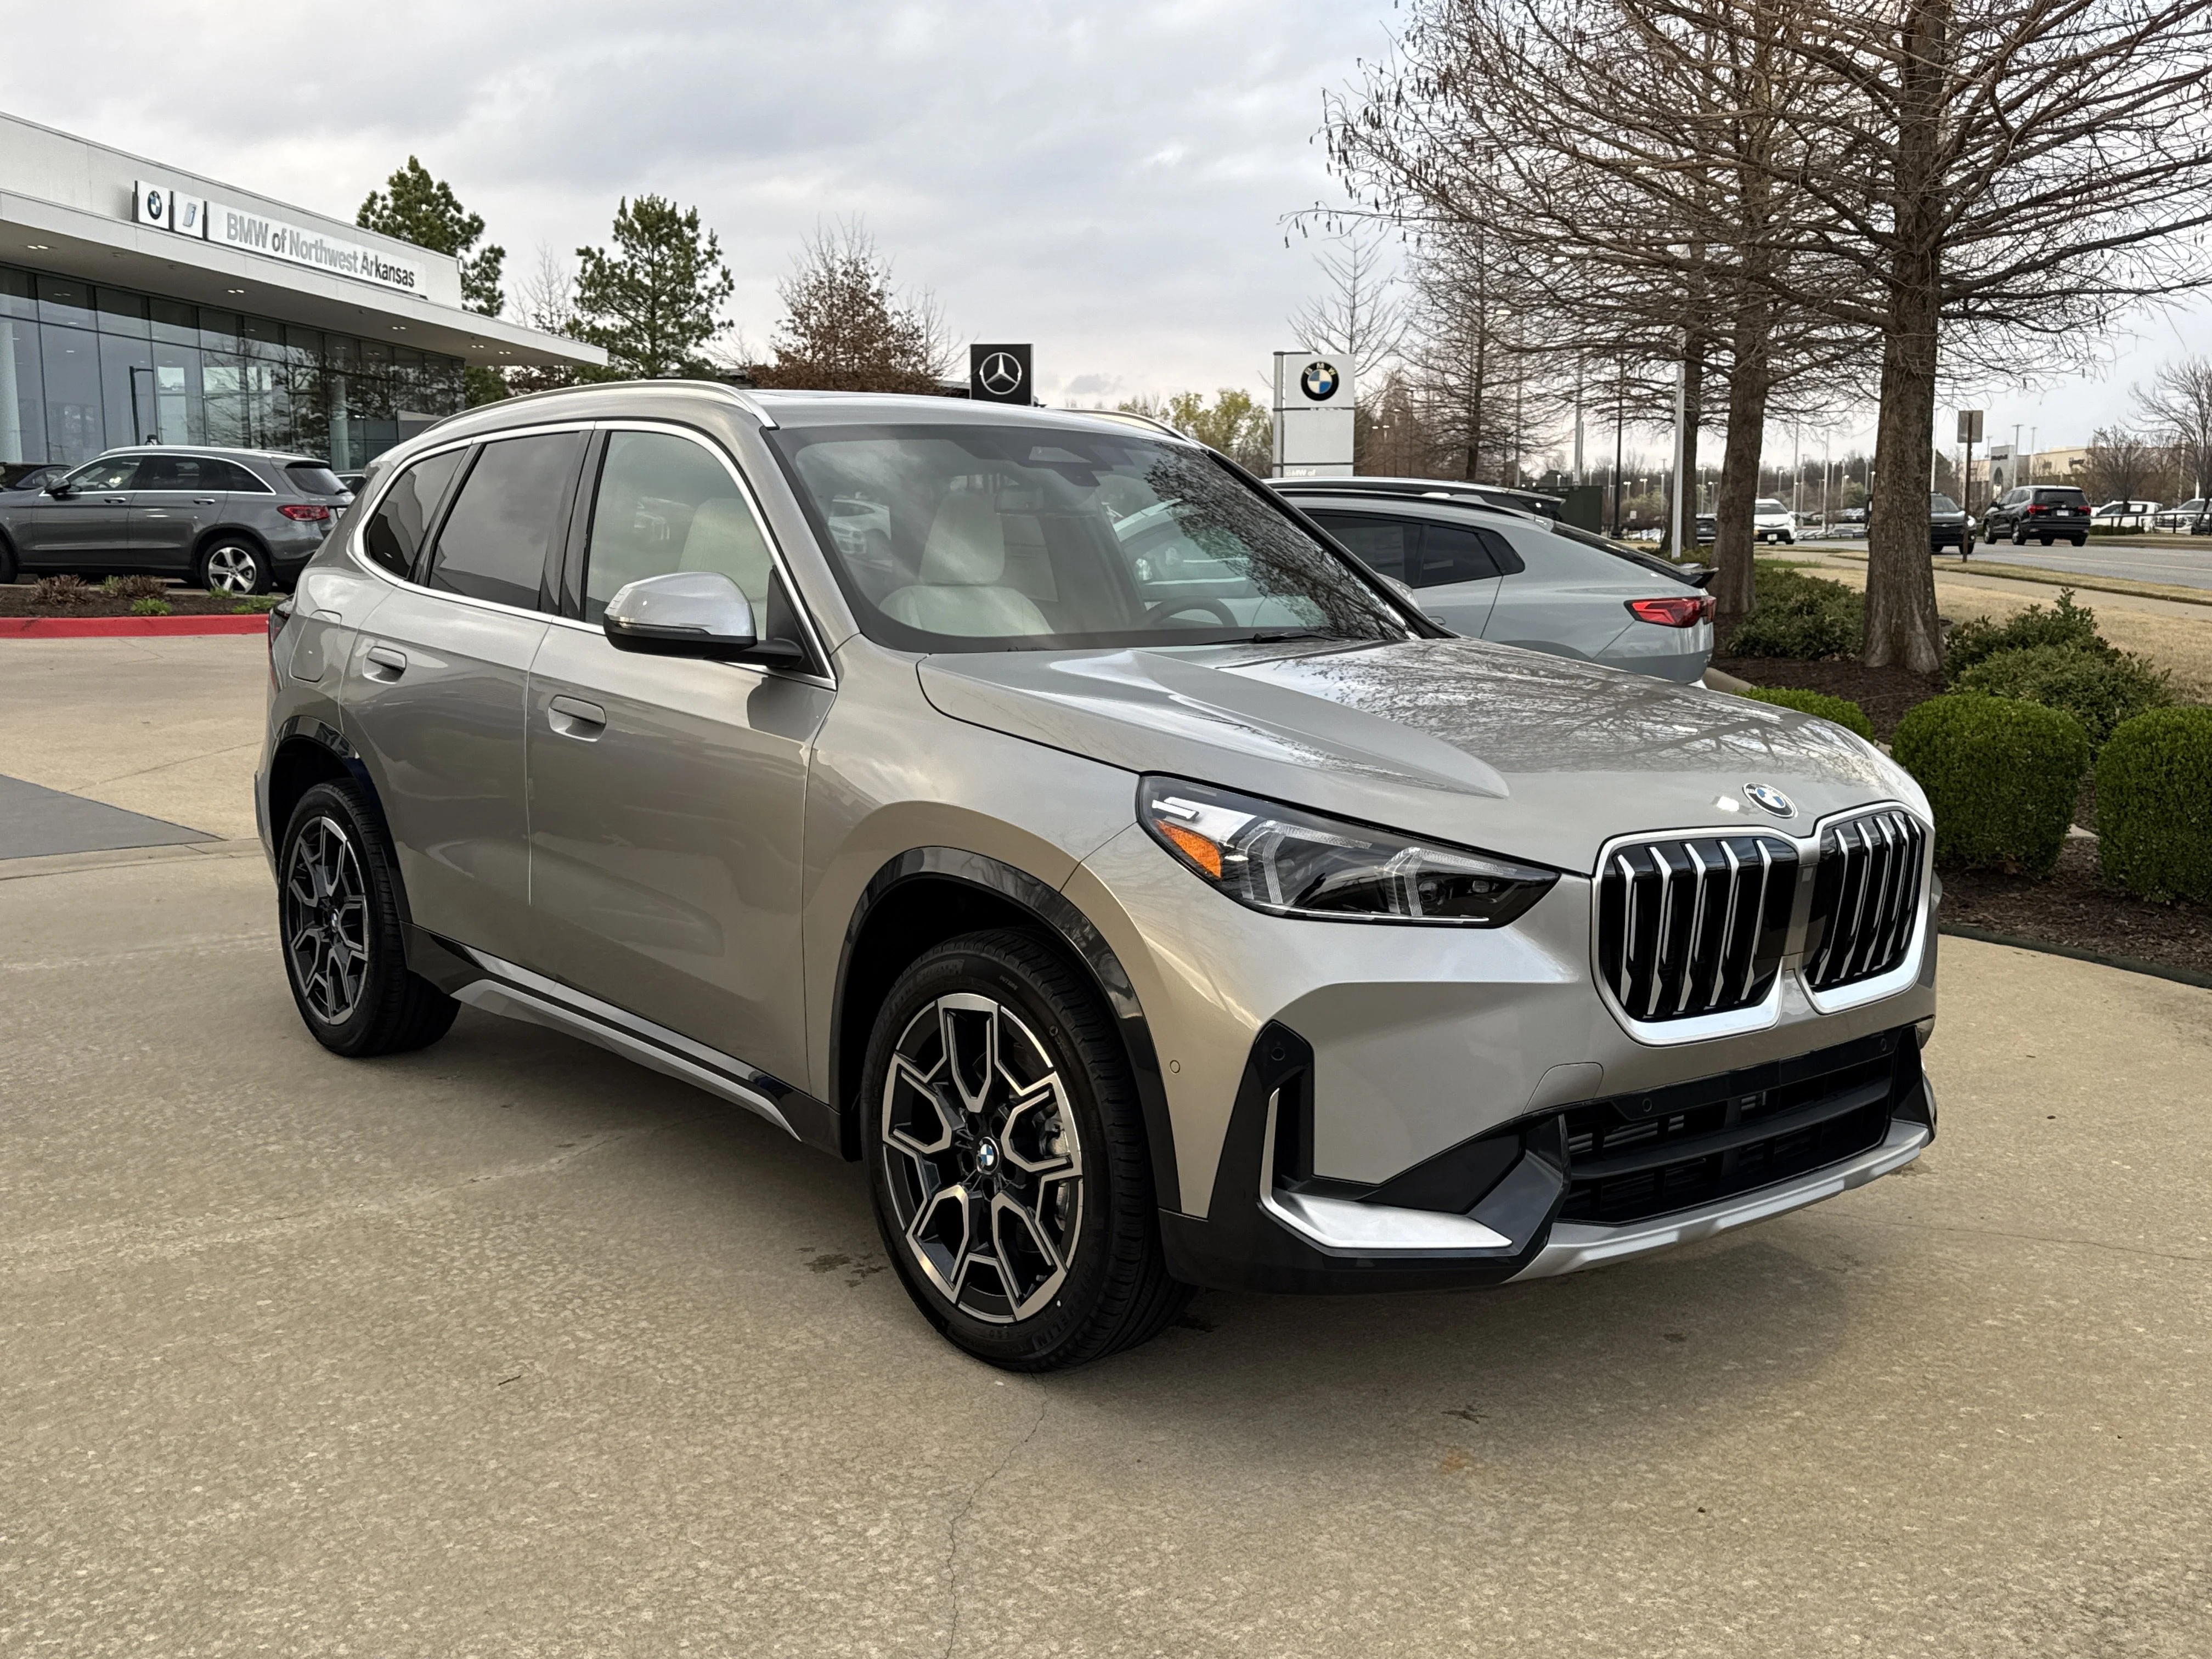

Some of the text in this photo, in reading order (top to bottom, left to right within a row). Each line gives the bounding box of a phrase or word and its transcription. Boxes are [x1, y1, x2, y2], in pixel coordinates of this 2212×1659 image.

[227, 213, 415, 288] BMW of Northwest Arkansas
[1304, 363, 1336, 376] BMW
